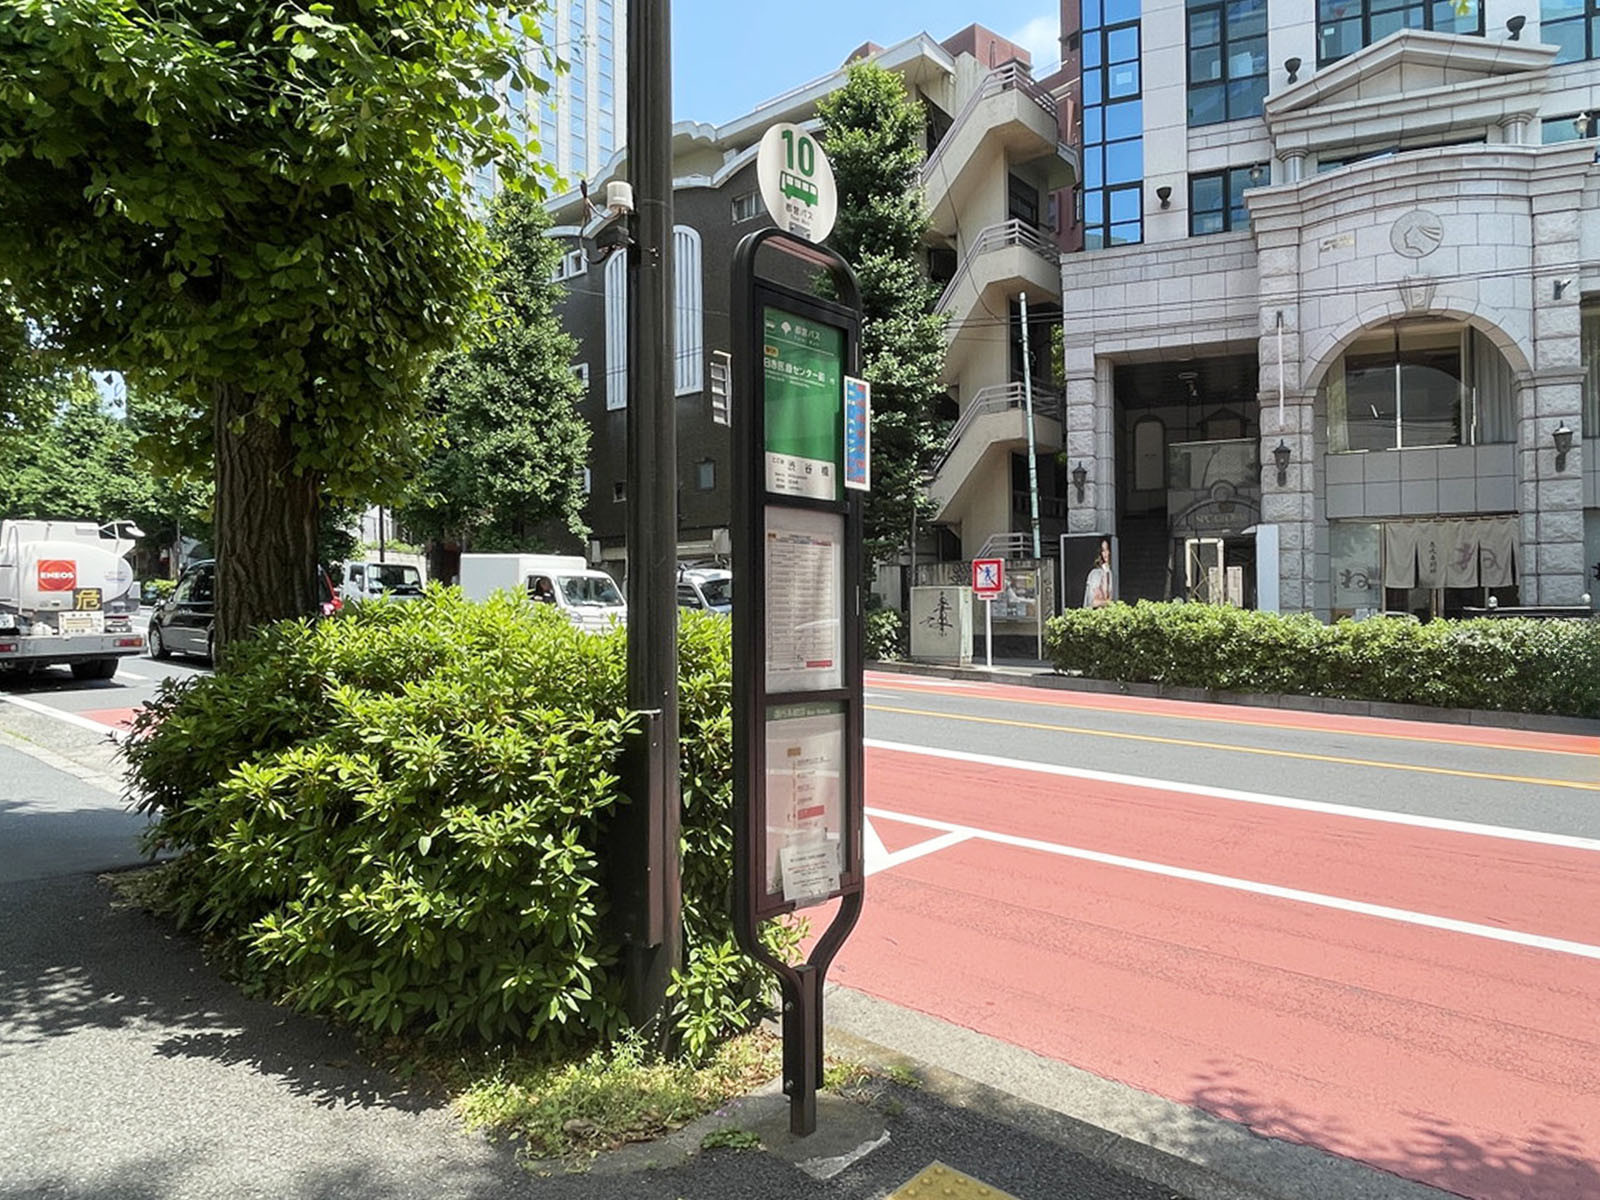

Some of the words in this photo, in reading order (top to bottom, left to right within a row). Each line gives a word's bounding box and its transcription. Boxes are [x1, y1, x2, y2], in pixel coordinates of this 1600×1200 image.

[782, 129, 814, 177] 10
[40, 571, 74, 580] ENEOS
[75, 589, 101, 610] 危
